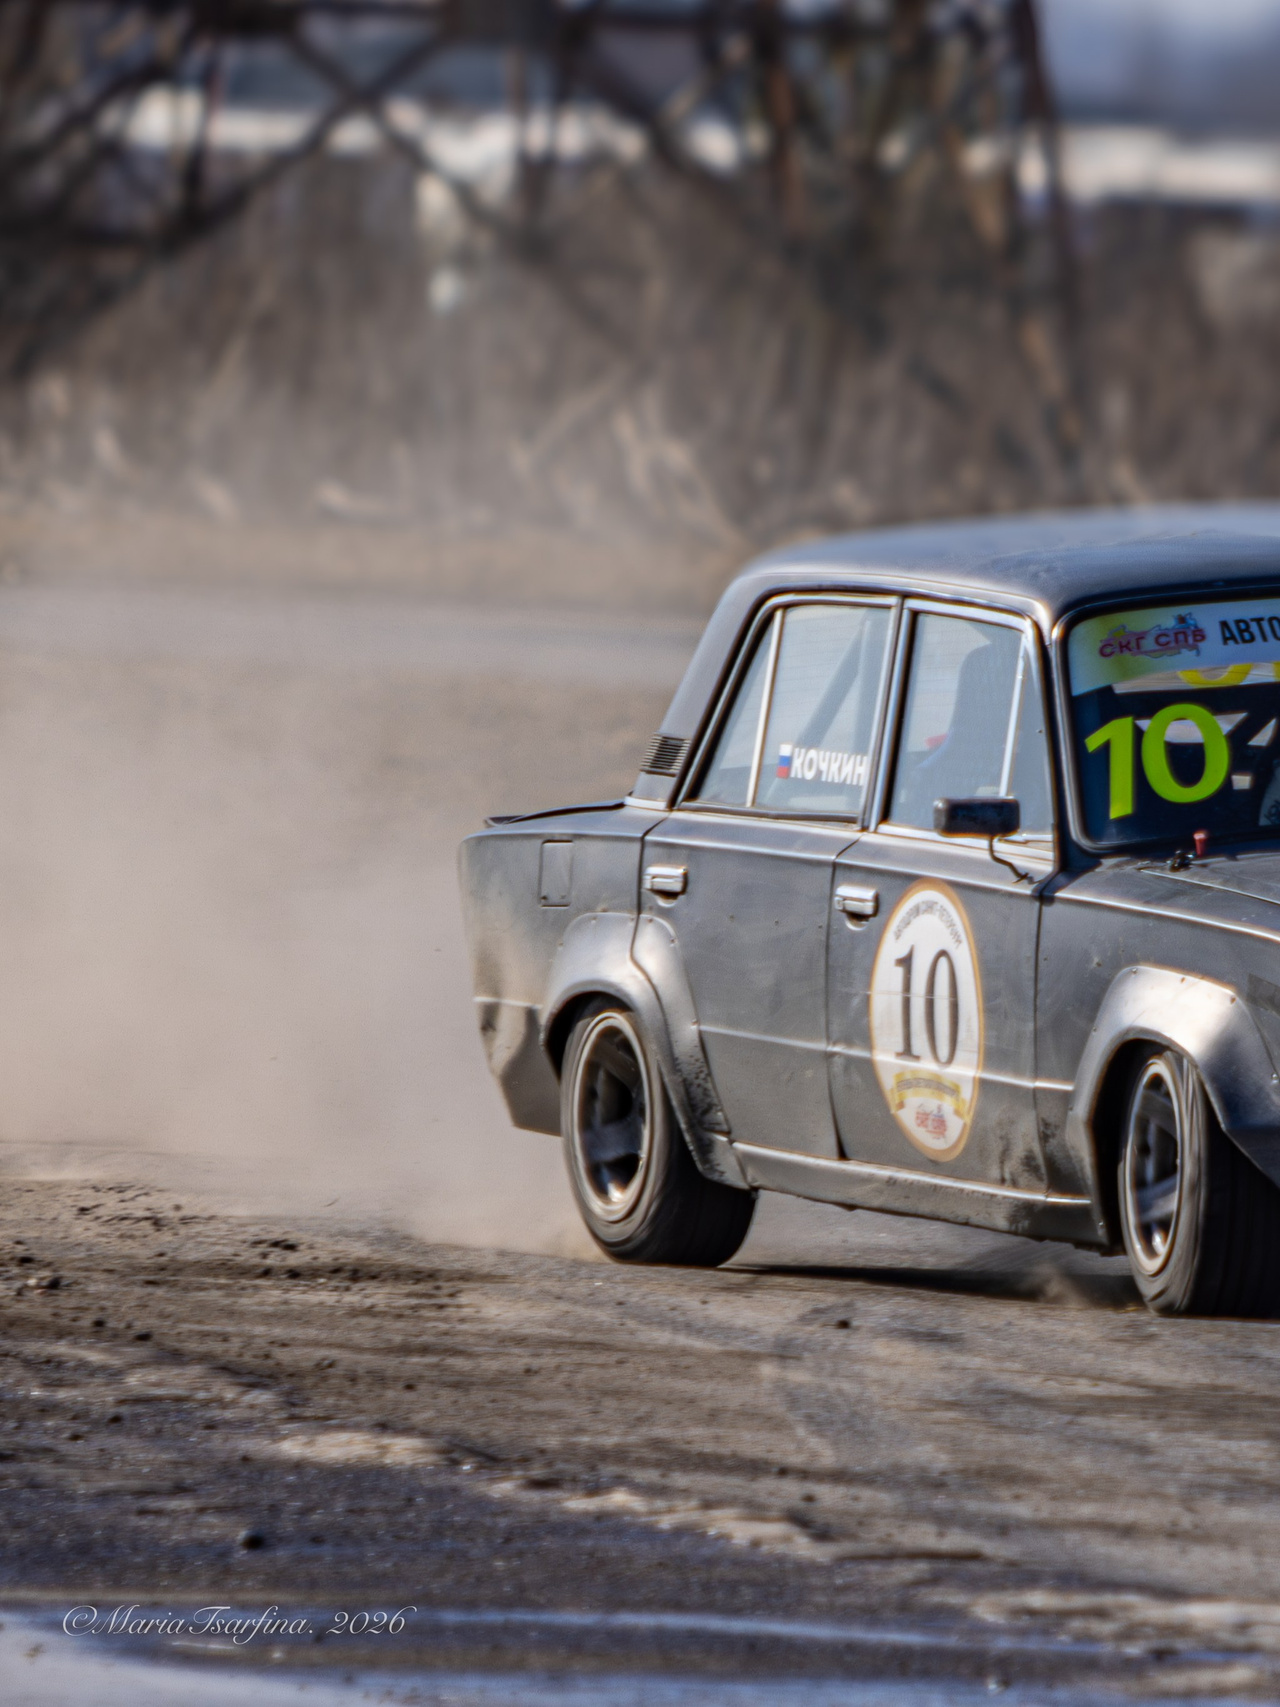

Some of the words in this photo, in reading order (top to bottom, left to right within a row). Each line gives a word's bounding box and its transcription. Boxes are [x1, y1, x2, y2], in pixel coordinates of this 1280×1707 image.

[1098, 634, 1146, 658] СКГ
[1154, 628, 1206, 648] СПБ
[790, 747, 868, 786] КОЧКИН
[1085, 703, 1229, 820] 10
[894, 944, 959, 1068] 10
